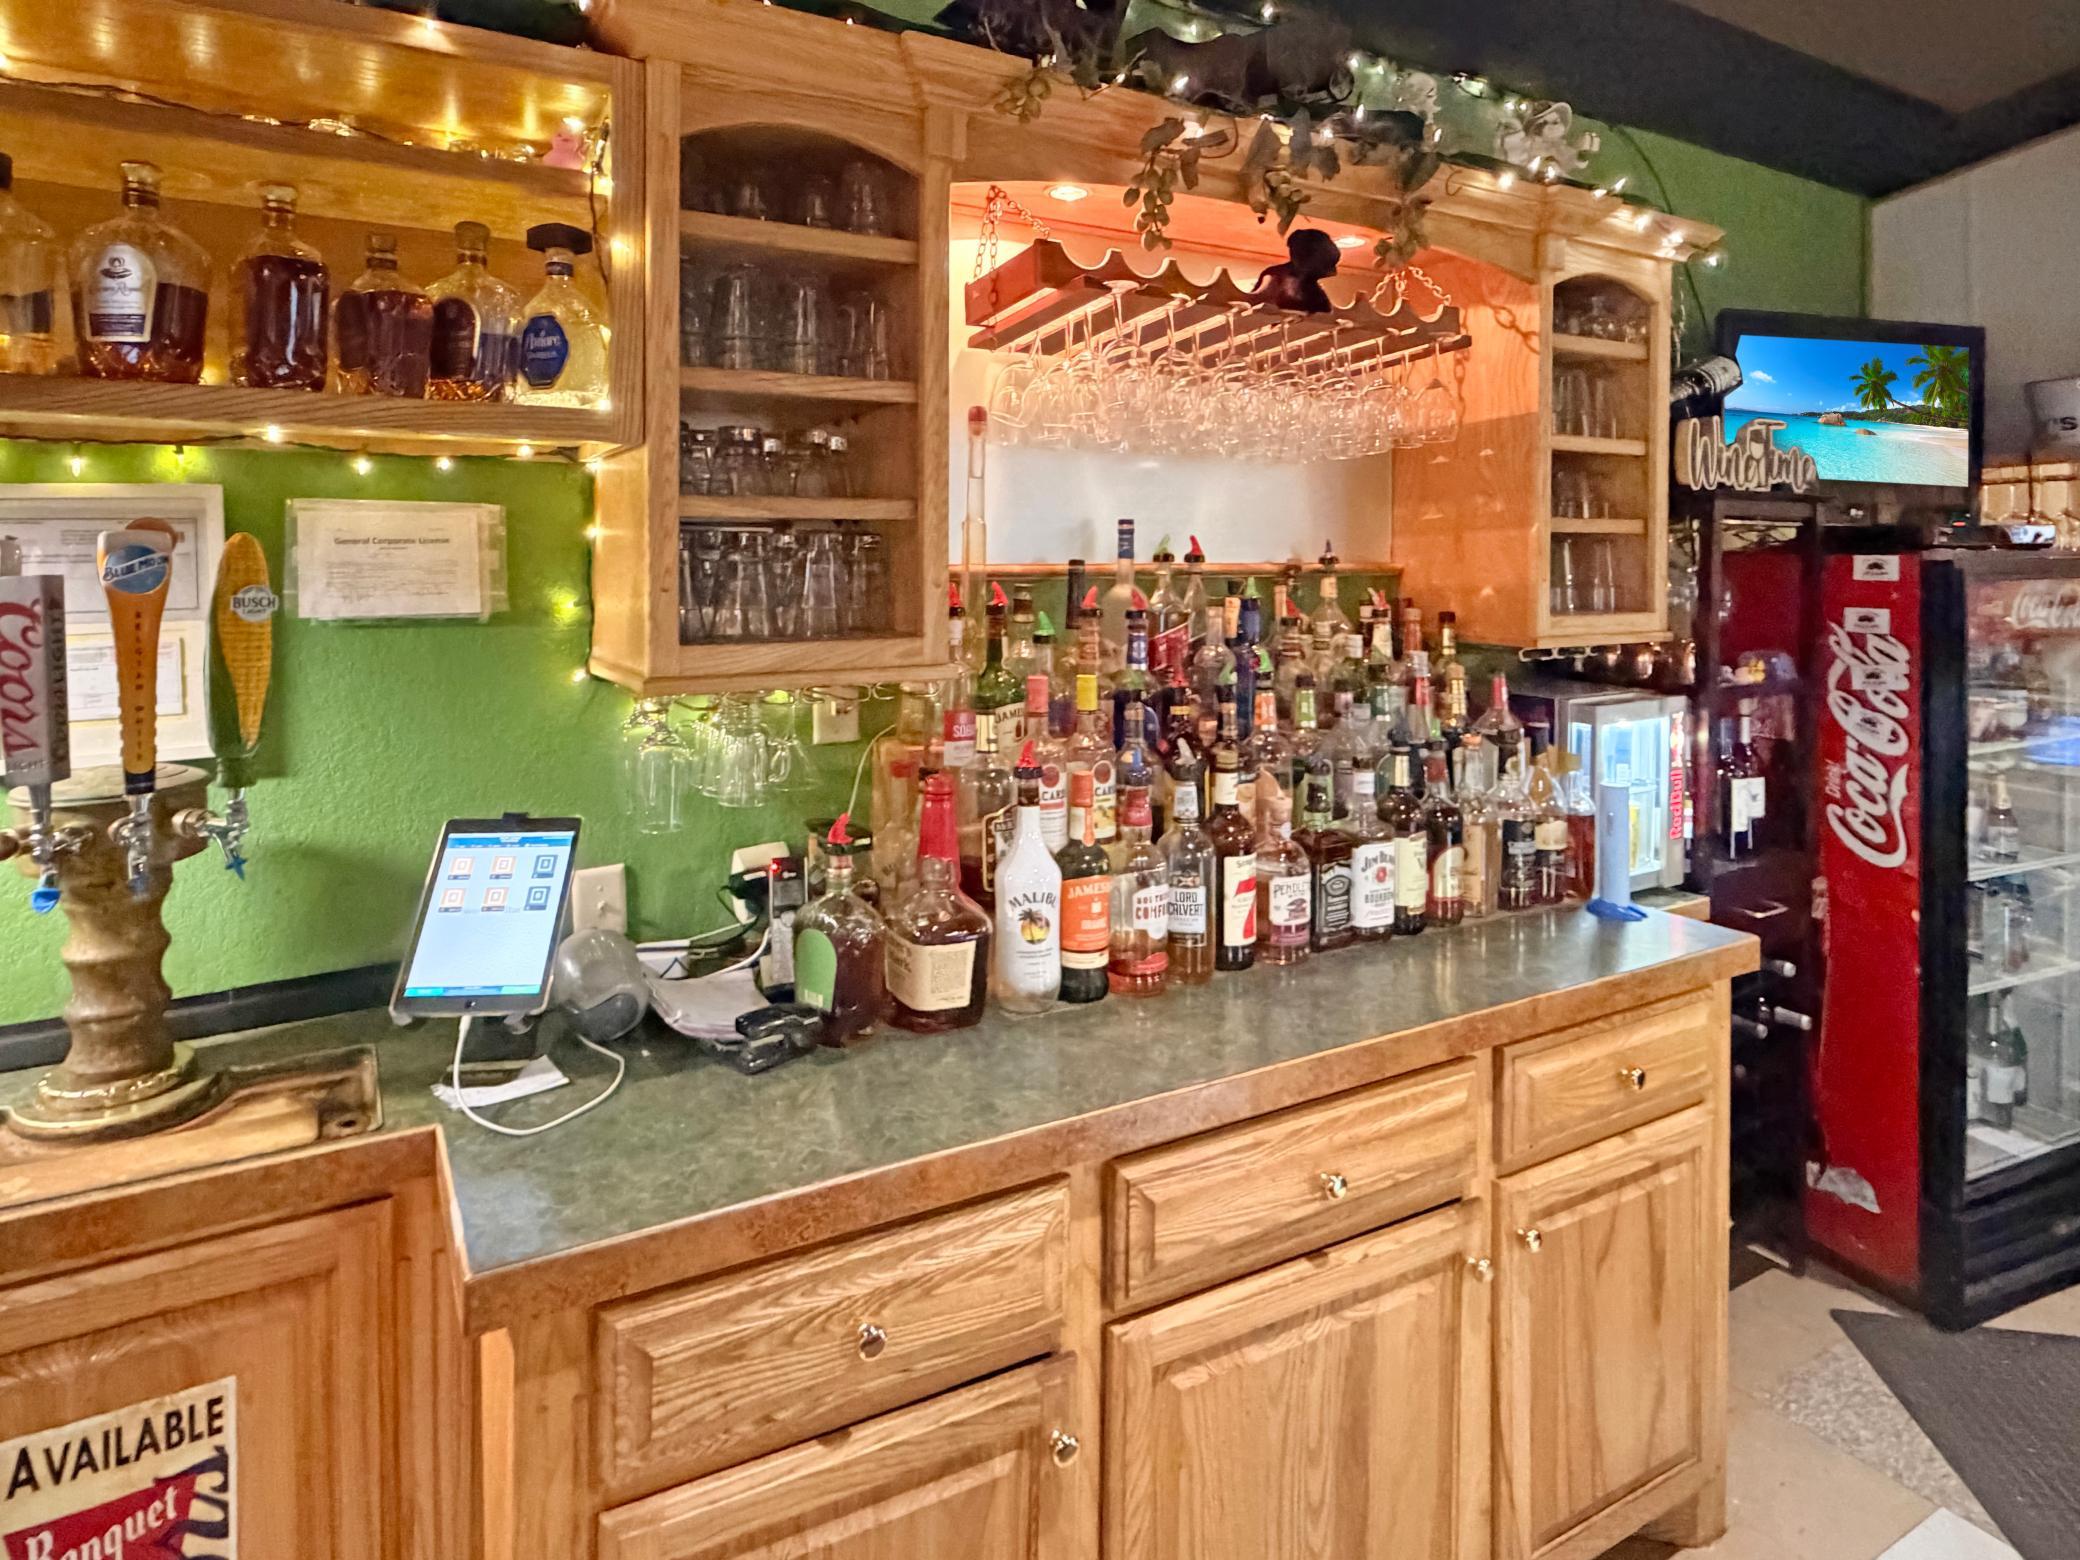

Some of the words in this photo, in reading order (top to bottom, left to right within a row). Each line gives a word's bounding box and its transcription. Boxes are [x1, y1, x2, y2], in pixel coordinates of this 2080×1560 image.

[333, 537, 370, 546] General
[418, 537, 450, 545] License
[102, 562, 136, 582] BLUE
[232, 597, 276, 609] BUSCH
[0, 597, 43, 758] Coors
[1174, 890, 1199, 904] LORD
[6, 1395, 225, 1500] AVAILABLE
